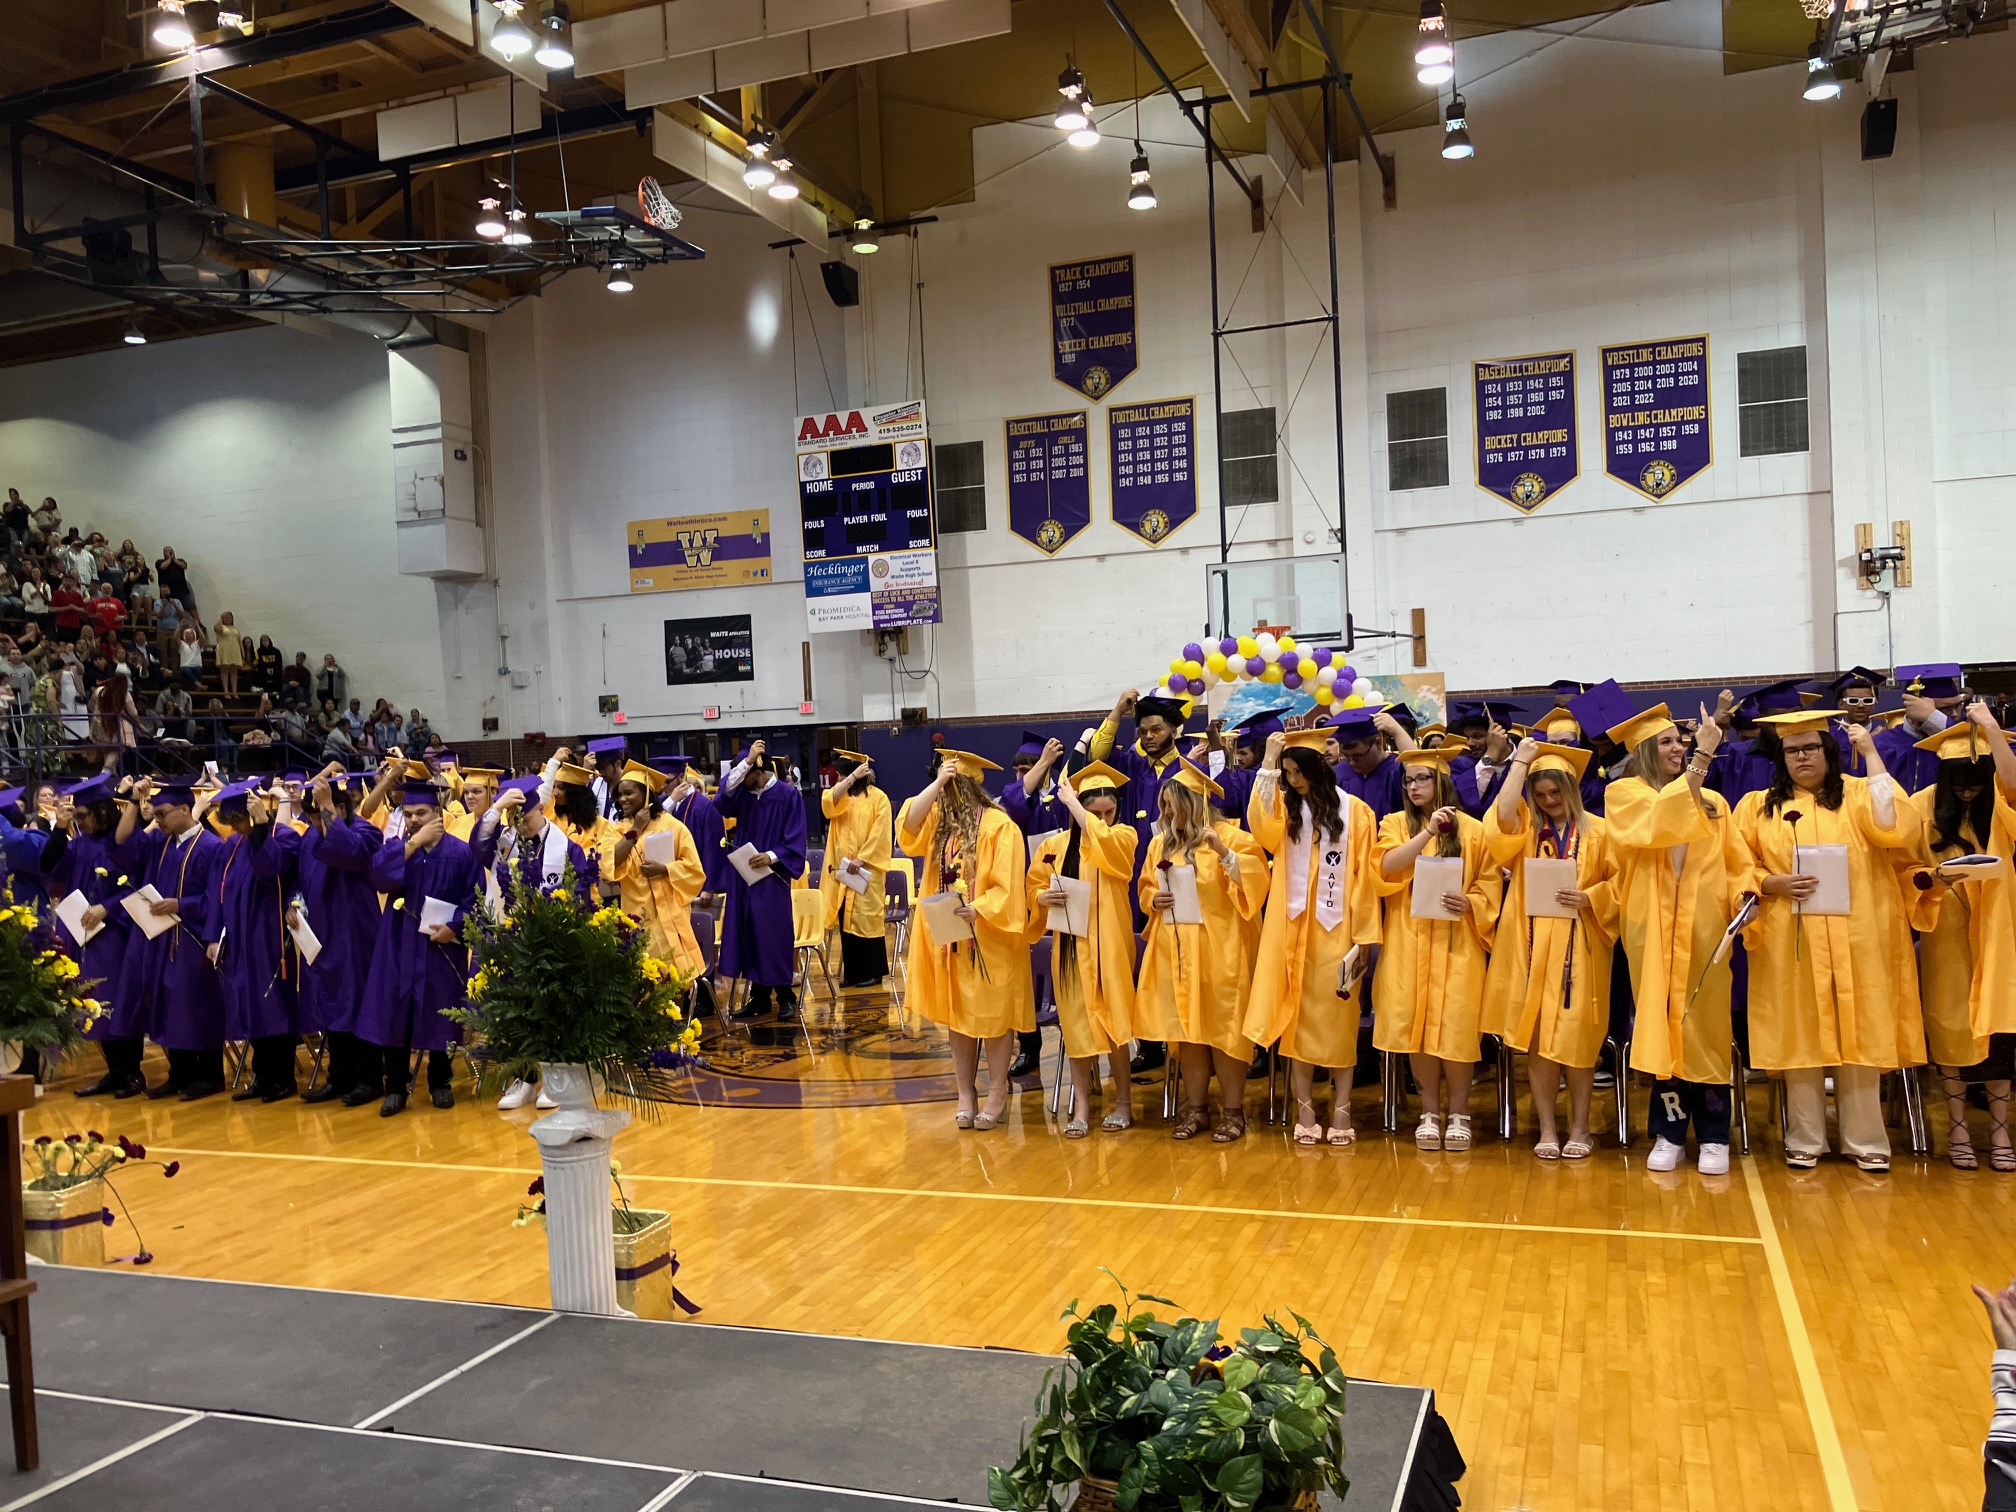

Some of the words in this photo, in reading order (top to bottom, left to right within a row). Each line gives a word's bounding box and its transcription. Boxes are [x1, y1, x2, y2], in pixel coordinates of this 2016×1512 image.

[1056, 267, 1081, 282] TRACK
[1084, 260, 1129, 278] CHAMPIONS
[1059, 282, 1072, 292] 1927
[1076, 280, 1090, 289] 1954
[1056, 301, 1095, 317] VOLLEYBALL
[1097, 296, 1132, 312] CHAMPIONS
[1060, 317, 1075, 327] 1973
[1058, 339, 1086, 353] SOCCER
[1089, 332, 1132, 349] CHAMPIONS
[1062, 354, 1076, 363] 1999
[1607, 348, 1653, 366] WRESTLING
[1655, 342, 1703, 360] CHAMPIONS
[1479, 364, 1522, 381] BASEBALL
[1523, 358, 1570, 375] CHAMPIONS
[1613, 369, 1630, 380] 1979
[1634, 366, 1653, 377] 2000
[1656, 364, 1675, 375] 2003
[1678, 361, 1698, 372] 2004
[1485, 384, 1501, 394] 1924
[1506, 381, 1523, 391] 1933
[1526, 379, 1543, 389] 1942
[1549, 377, 1564, 387] 1951
[1613, 382, 1631, 393] 2005
[1635, 380, 1652, 390] 2014
[1657, 377, 1674, 388] 2019
[1679, 375, 1698, 386] 2020
[1485, 397, 1502, 407] 1954
[1507, 394, 1523, 405] 1957
[1527, 392, 1544, 403] 1960
[1549, 390, 1565, 400] 1967
[1613, 396, 1630, 407] 2021
[1635, 393, 1654, 404] 2022
[1112, 408, 1148, 424] FOOTBALL
[1150, 403, 1191, 419] CHAMPIONS
[1486, 410, 1502, 420] 1982
[1507, 408, 1523, 418] 1988
[1527, 405, 1545, 416] 2002
[1609, 411, 1650, 427] BOWLING
[1652, 406, 1705, 423] CHAMPIONS
[798, 411, 868, 440] AAA
[879, 424, 922, 434] 419-535-0274
[1010, 420, 1048, 436] BASKETBALL
[1050, 416, 1084, 431] CHAMPIONS
[1118, 429, 1131, 438] 1921
[1135, 426, 1150, 436] 1924
[1153, 424, 1168, 434] 1925
[1171, 422, 1185, 432] 1926
[1615, 430, 1632, 441] 1943
[1637, 428, 1654, 439] 1947
[1659, 426, 1676, 437] 1957
[1681, 424, 1699, 435] 1958
[829, 435, 857, 443] SERVICES,
[1019, 440, 1035, 448] BOYS
[1058, 436, 1075, 444] GIRLS
[1118, 441, 1132, 451] 1929
[1136, 439, 1149, 448] 1931
[1154, 437, 1168, 447] 1932
[1172, 435, 1186, 444] 1933
[1485, 434, 1517, 450] HOCKEY
[1521, 429, 1568, 447] CHAMPIONS
[1013, 450, 1025, 459] 1921
[1030, 448, 1043, 457] 1932
[1052, 446, 1064, 455] 1971
[1616, 444, 1632, 454] 1959
[1638, 442, 1655, 453] 1962
[1660, 440, 1677, 451] 1988
[1051, 457, 1066, 467] 2005
[1069, 455, 1084, 465] 2006
[1118, 453, 1132, 463] 1934
[1136, 451, 1150, 461] 1936
[1154, 449, 1168, 459] 1937
[1172, 447, 1186, 457] 1939
[1486, 453, 1503, 463] 1976
[1507, 451, 1523, 462] 1977
[1528, 449, 1545, 460] 1978
[1549, 447, 1566, 457] 1979
[1013, 462, 1026, 471] 1933
[1052, 469, 1066, 479] 2007
[1070, 468, 1084, 477] 2010
[1119, 465, 1133, 475] 1940
[1137, 463, 1151, 473] 1943
[1154, 461, 1169, 471] 1945
[1172, 459, 1187, 469] 1946
[891, 470, 922, 483] GUEST
[1013, 474, 1026, 483] 1953
[1030, 472, 1044, 481] 1974
[1119, 478, 1133, 487] 1947
[1137, 476, 1151, 485] 1948
[1155, 474, 1169, 484] 1956
[1173, 472, 1187, 482] 1963
[806, 480, 833, 493] HOME
[852, 481, 874, 491] PERIOD
[844, 515, 868, 525] PLAYER
[871, 514, 887, 522] FOUL
[907, 509, 928, 518] FOULS
[667, 516, 727, 527] Waiteathletics.com
[805, 520, 824, 529] FOULS
[677, 529, 719, 568] W
[857, 544, 879, 553] MATCH
[909, 539, 930, 548] SCORE
[806, 550, 826, 559] SCORE
[807, 563, 865, 577] Hecklinger
[896, 578, 924, 586] Indians!
[715, 648, 750, 658] HOUSE
[705, 708, 716, 717] EXIT
[819, 774, 830, 788] 11
[1327, 873, 1335, 908] AVID
[1661, 1092, 1686, 1121] R
